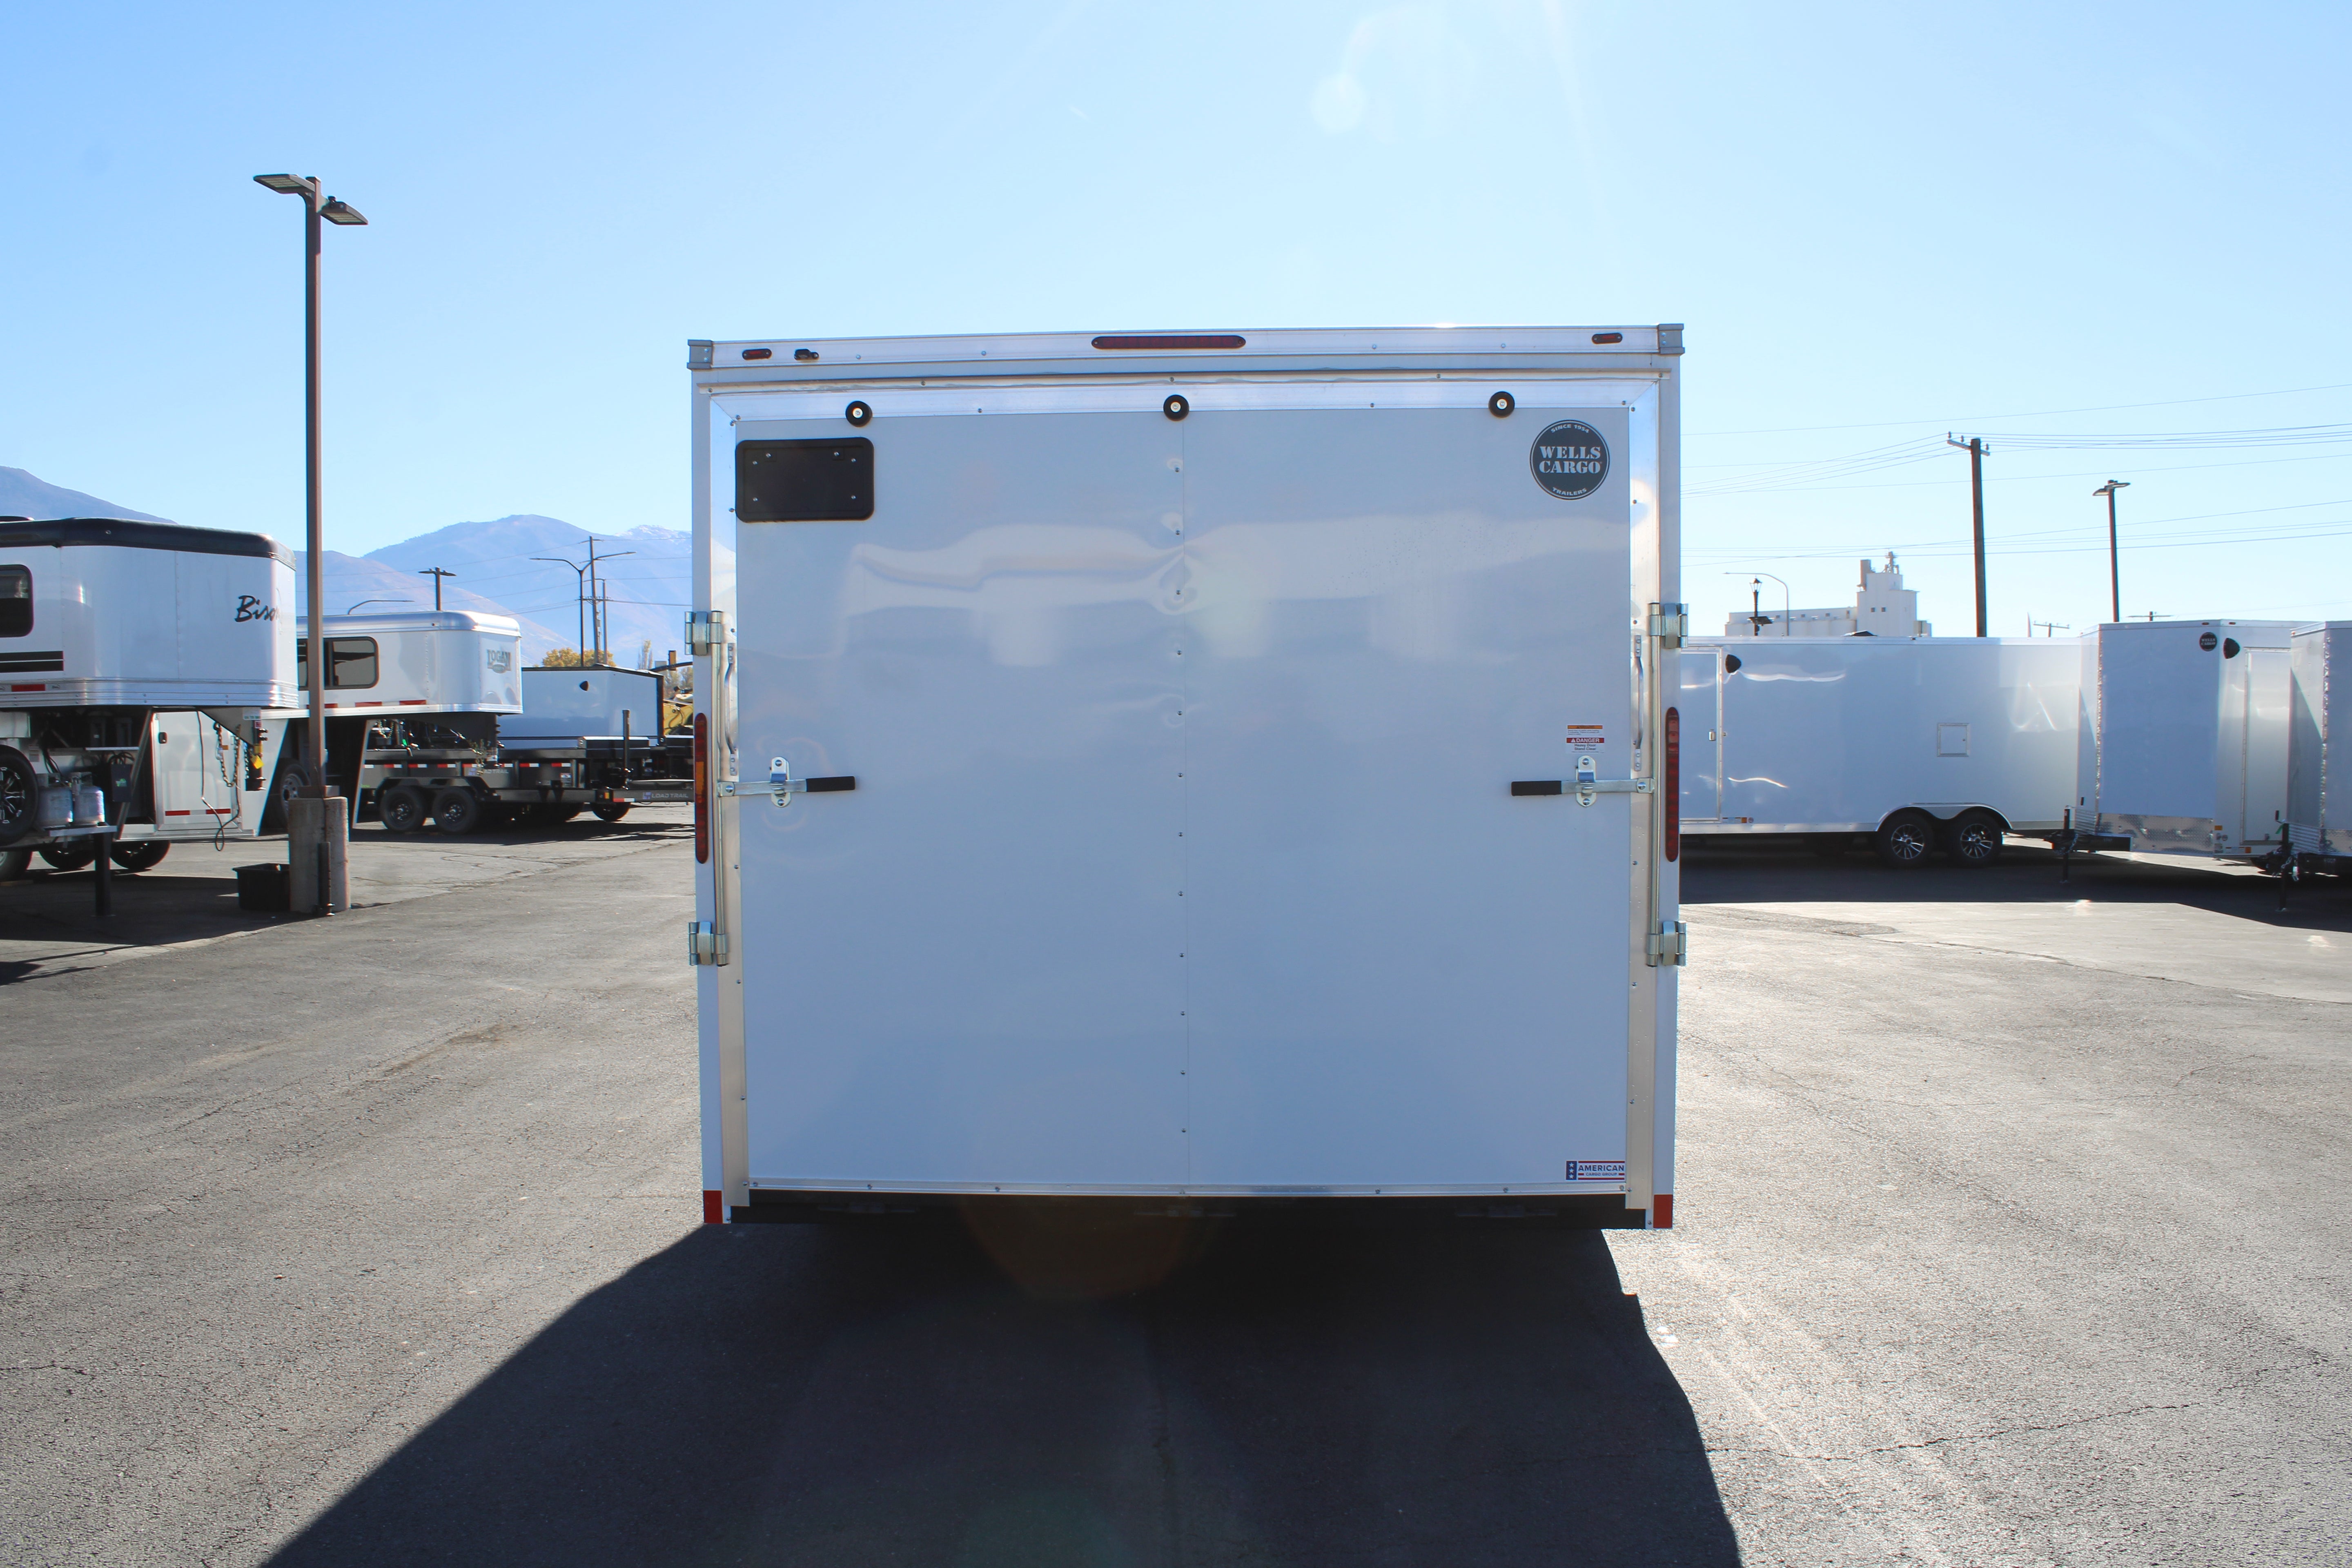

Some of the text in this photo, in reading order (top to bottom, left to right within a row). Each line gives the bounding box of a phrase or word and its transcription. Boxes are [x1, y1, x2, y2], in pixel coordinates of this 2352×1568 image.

[1550, 424, 1590, 433] SINCE 1954
[1539, 446, 1601, 459] WELLS
[1539, 460, 1601, 474] CARGO
[1552, 487, 1588, 496] TRAILERS
